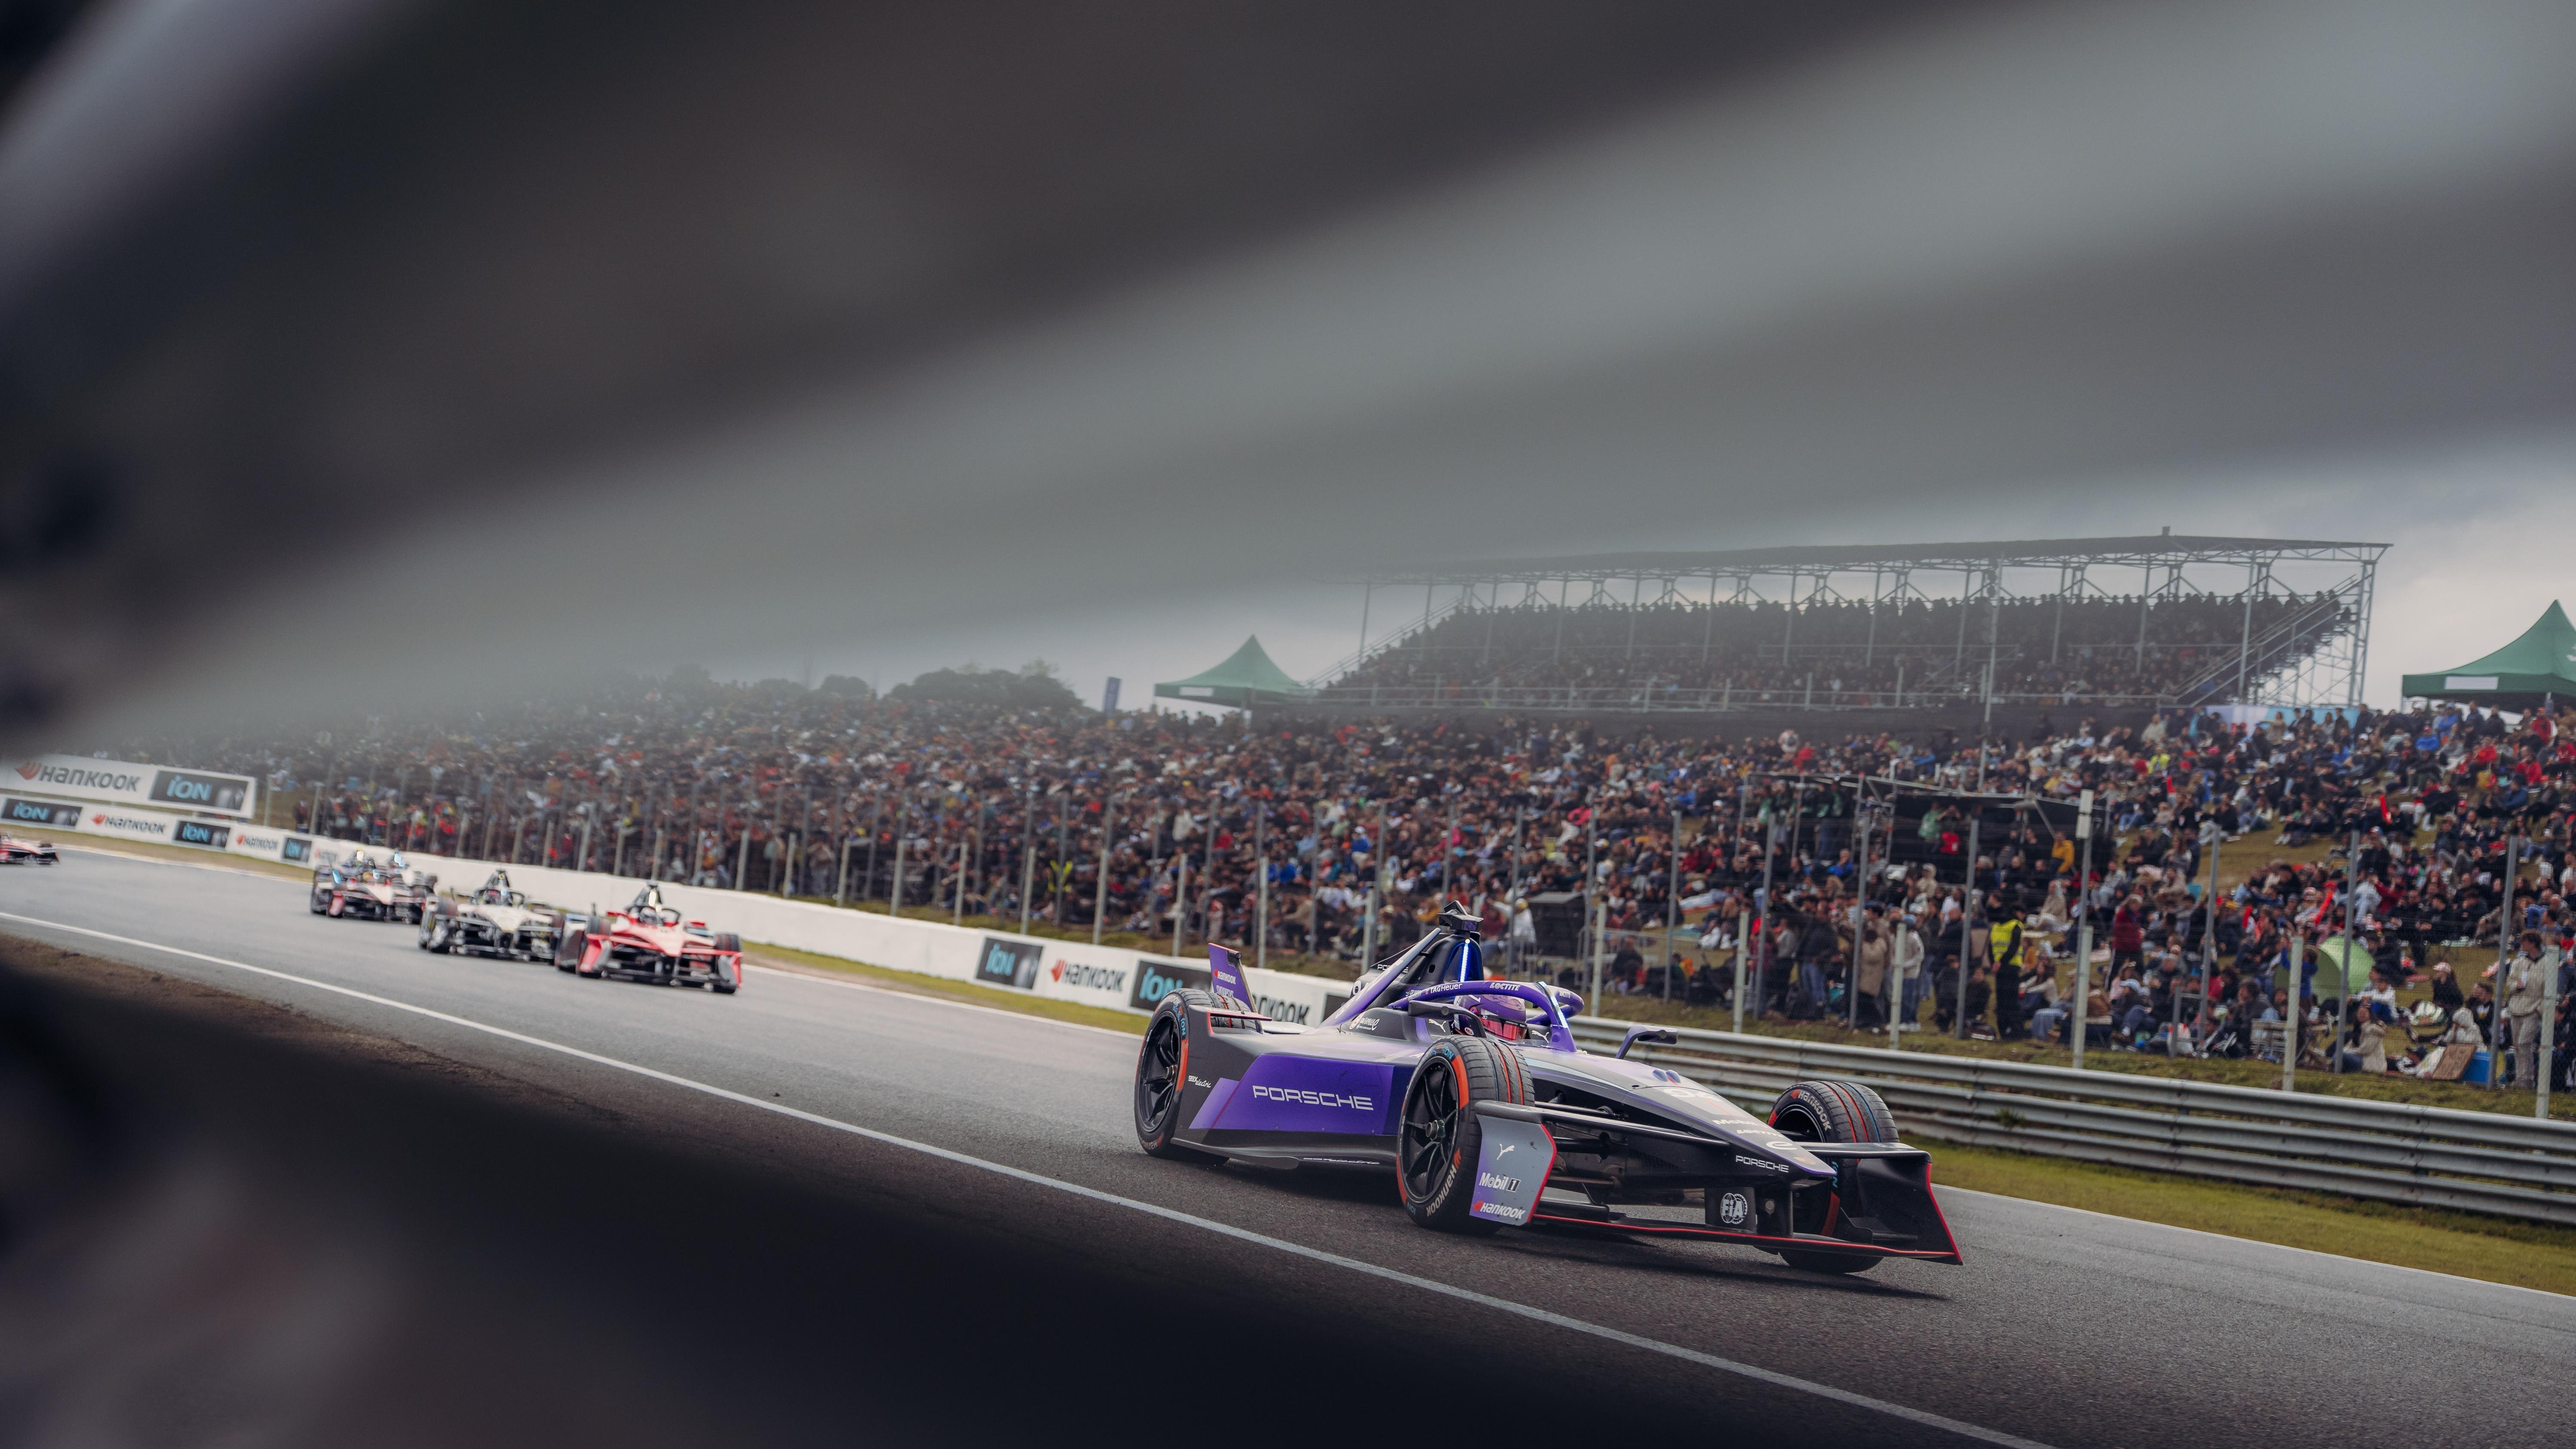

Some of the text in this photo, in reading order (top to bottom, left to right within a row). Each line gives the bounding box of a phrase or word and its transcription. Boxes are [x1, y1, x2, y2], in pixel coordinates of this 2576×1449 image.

[38, 765, 141, 791] Hankook
[1061, 963, 1127, 993] Hankook
[1218, 970, 1236, 985] Hankook
[1489, 982, 1521, 991] LOCTITE
[1559, 989, 1571, 999] LOCTITE
[1252, 1085, 1374, 1111] PORSCHE
[1798, 1091, 1832, 1131] Hankook
[1736, 1155, 1789, 1173] PORSCHE
[1479, 1172, 1509, 1190] Mobil
[1425, 1164, 1457, 1217] Hankook
[1480, 1202, 1526, 1219] Hankook
